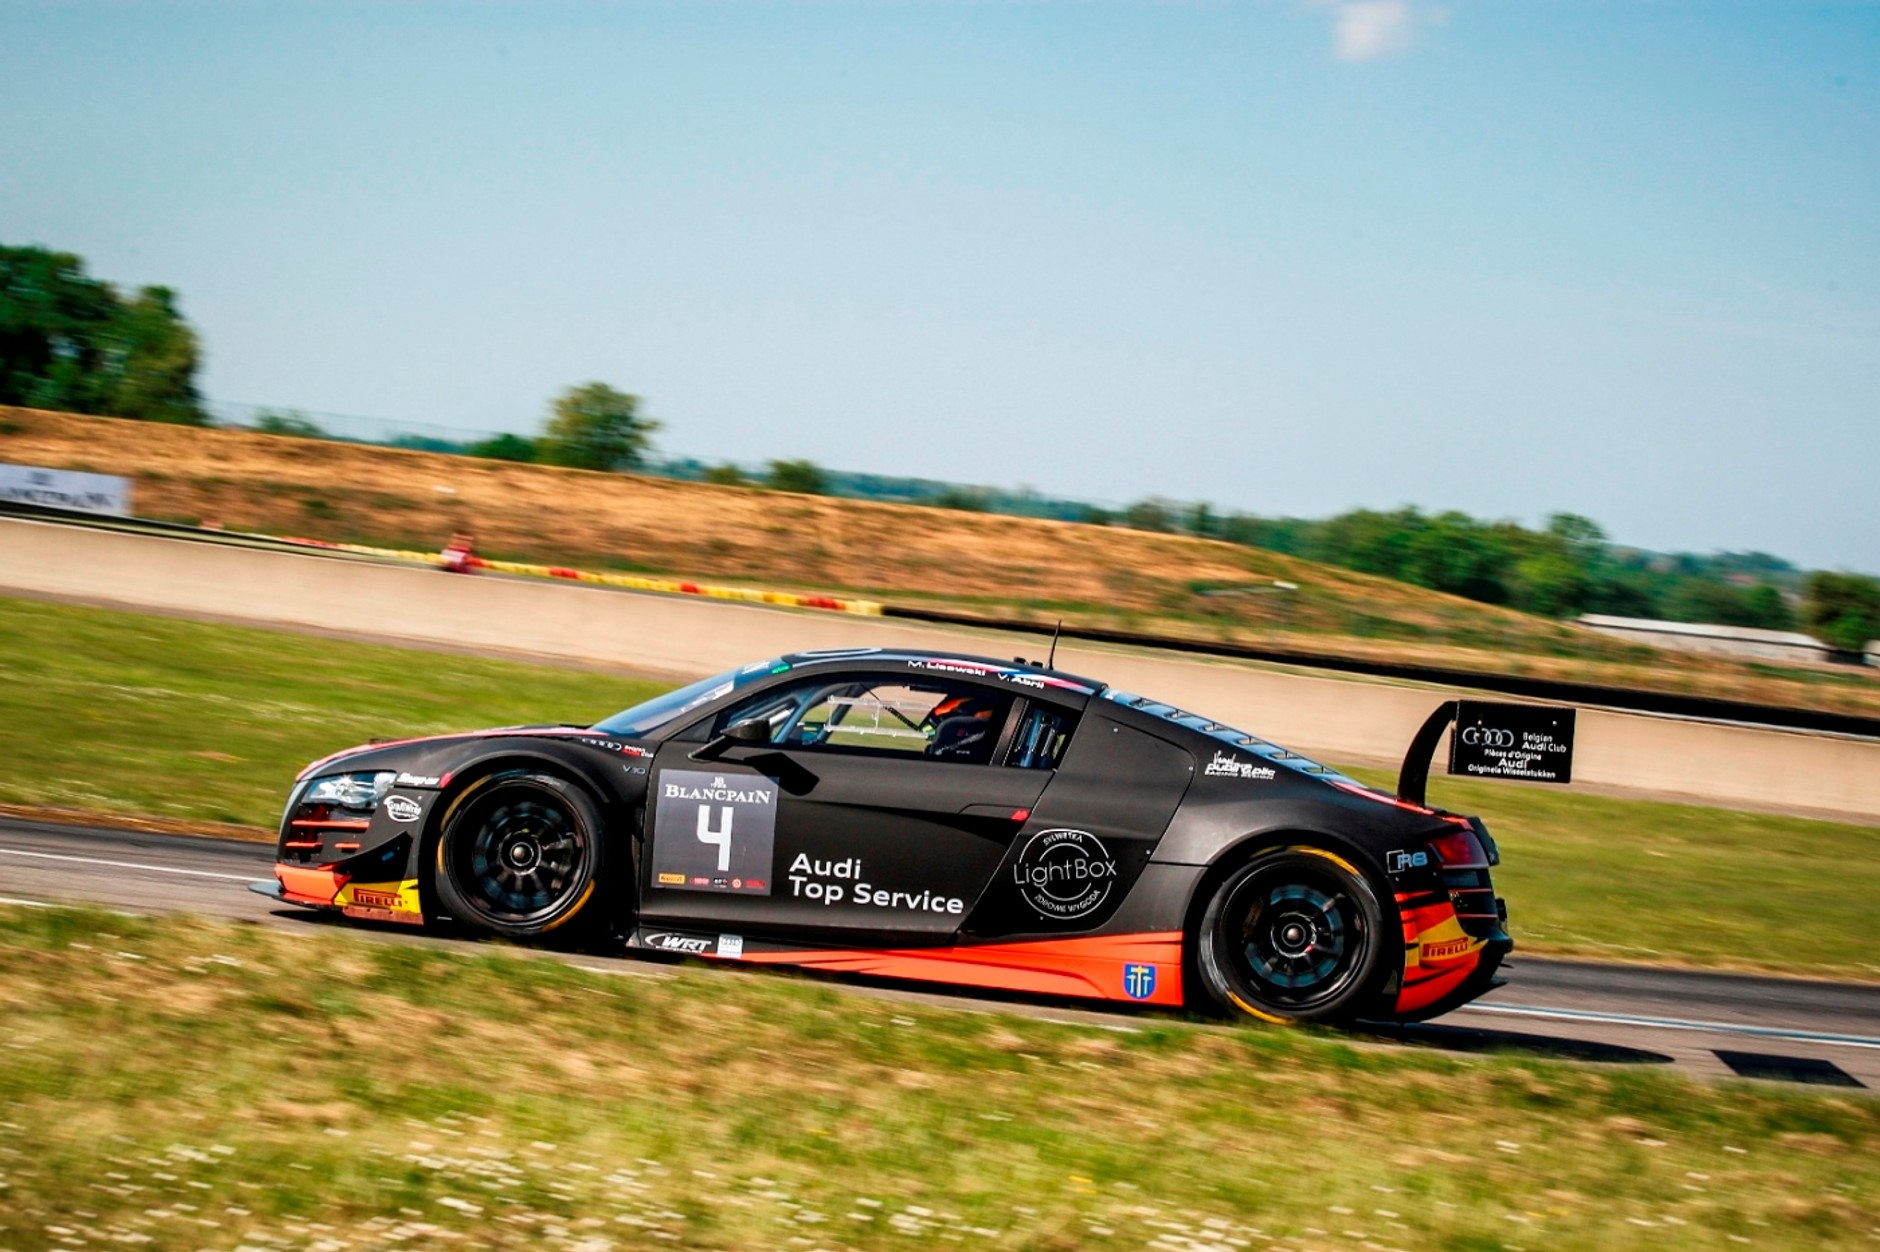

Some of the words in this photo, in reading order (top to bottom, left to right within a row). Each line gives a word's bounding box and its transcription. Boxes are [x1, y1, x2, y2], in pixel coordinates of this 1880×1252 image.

[1011, 676, 1045, 690] Abril
[1522, 732, 1553, 744] Belgian
[1521, 741, 1547, 752] Audi
[1548, 743, 1567, 753] Club
[622, 765, 646, 775] V10
[1498, 758, 1528, 769] Audi
[664, 783, 772, 804] BLANCPAIN
[696, 804, 734, 872] 4
[789, 852, 862, 880] Audi
[1396, 852, 1428, 869] R8
[1013, 858, 1117, 888] LightBox
[788, 874, 844, 906] Top
[852, 883, 964, 914] Service
[662, 935, 712, 952] WRT
